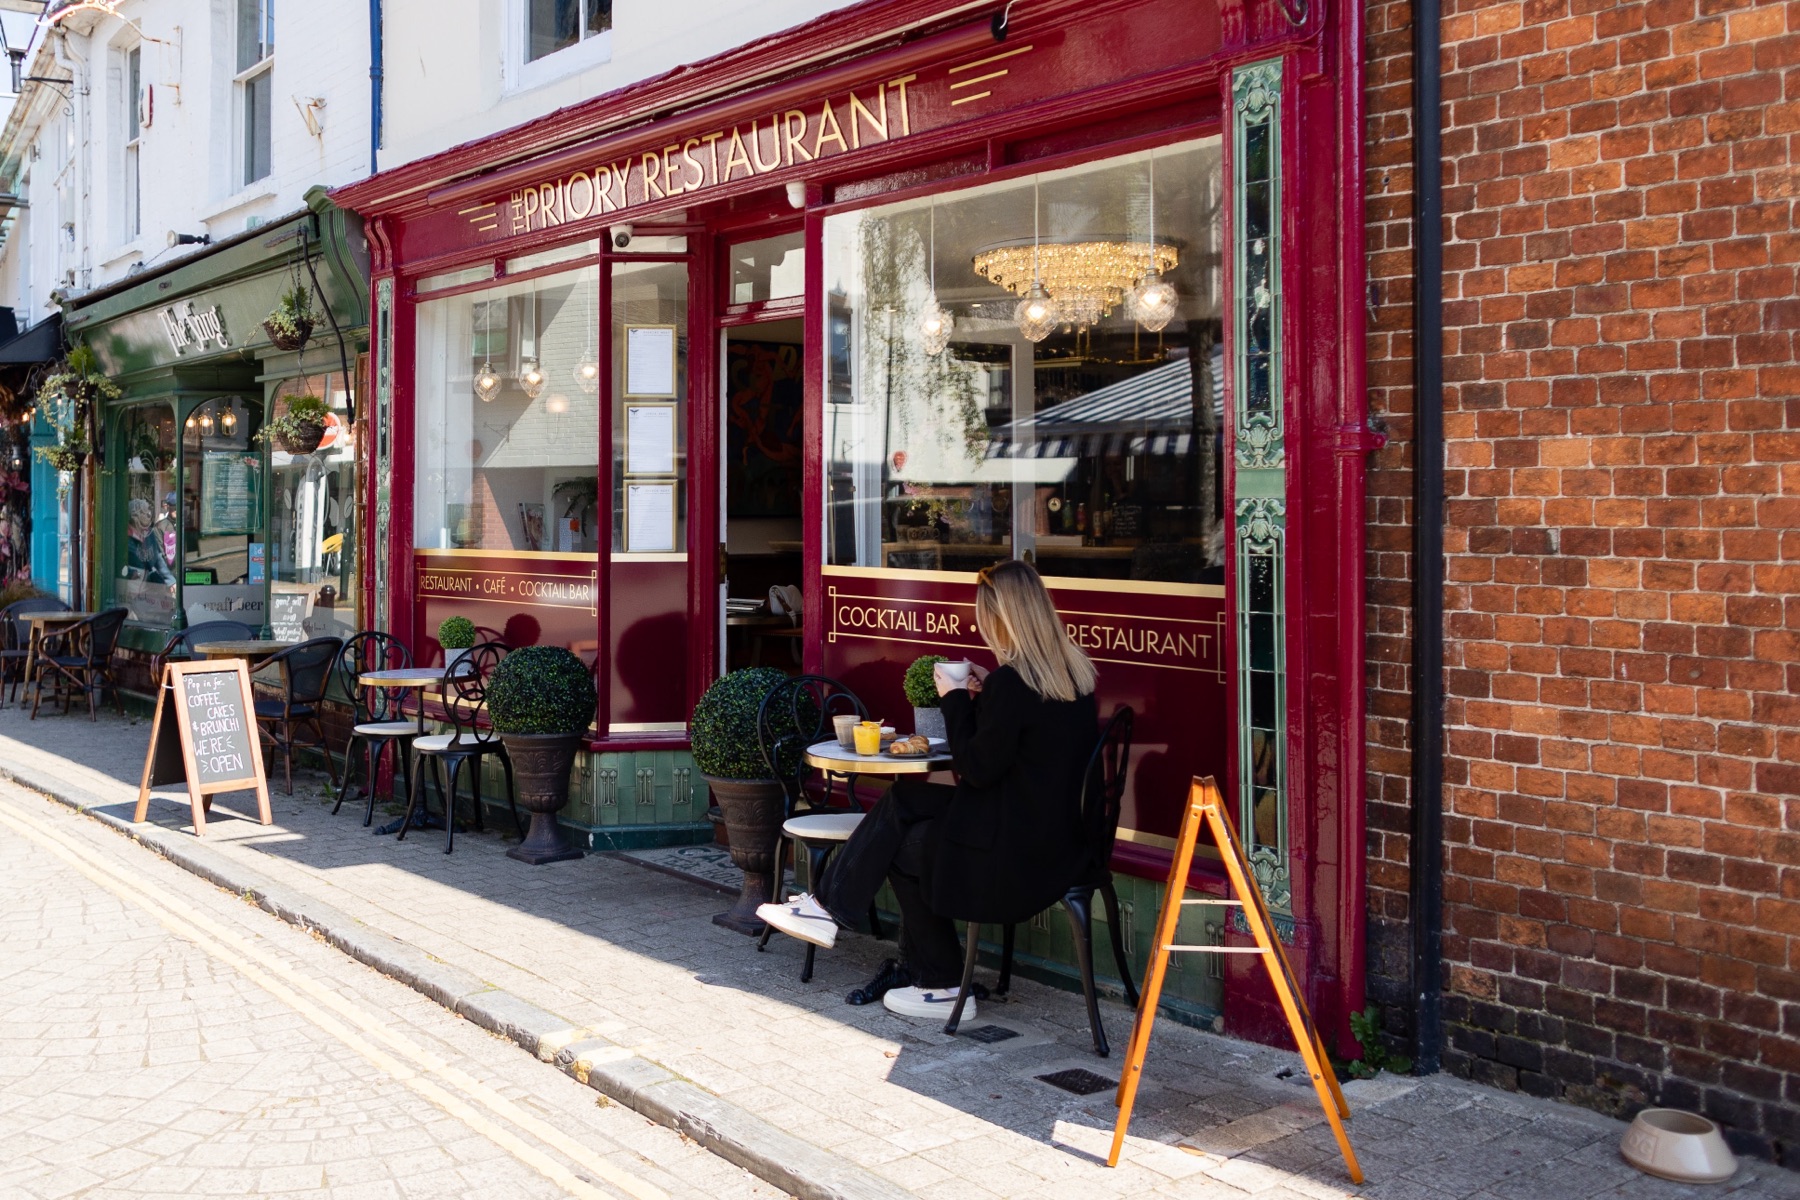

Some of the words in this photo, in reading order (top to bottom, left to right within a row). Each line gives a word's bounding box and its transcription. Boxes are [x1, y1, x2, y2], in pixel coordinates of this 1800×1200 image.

[511, 189, 525, 235] THE
[524, 157, 633, 233] PRIORY
[642, 74, 917, 202] RESTAURANT
[157, 308, 191, 357] The
[182, 304, 228, 352] Snug
[420, 575, 473, 592] RESTAURANT
[483, 576, 507, 595] CAFÉ
[518, 580, 568, 600] COCKTAIL
[569, 583, 590, 601] BAR
[203, 596, 233, 612] craft
[237, 597, 264, 611] beer
[838, 605, 923, 637] COCKTAIL
[926, 612, 961, 636] BAR
[1066, 623, 1212, 660] RESTAURANT
[187, 677, 200, 693] Pop
[203, 679, 212, 688] in
[207, 704, 235, 720] CAKES
[200, 717, 241, 737] BRUNCH!
[210, 752, 244, 774] OPEN
